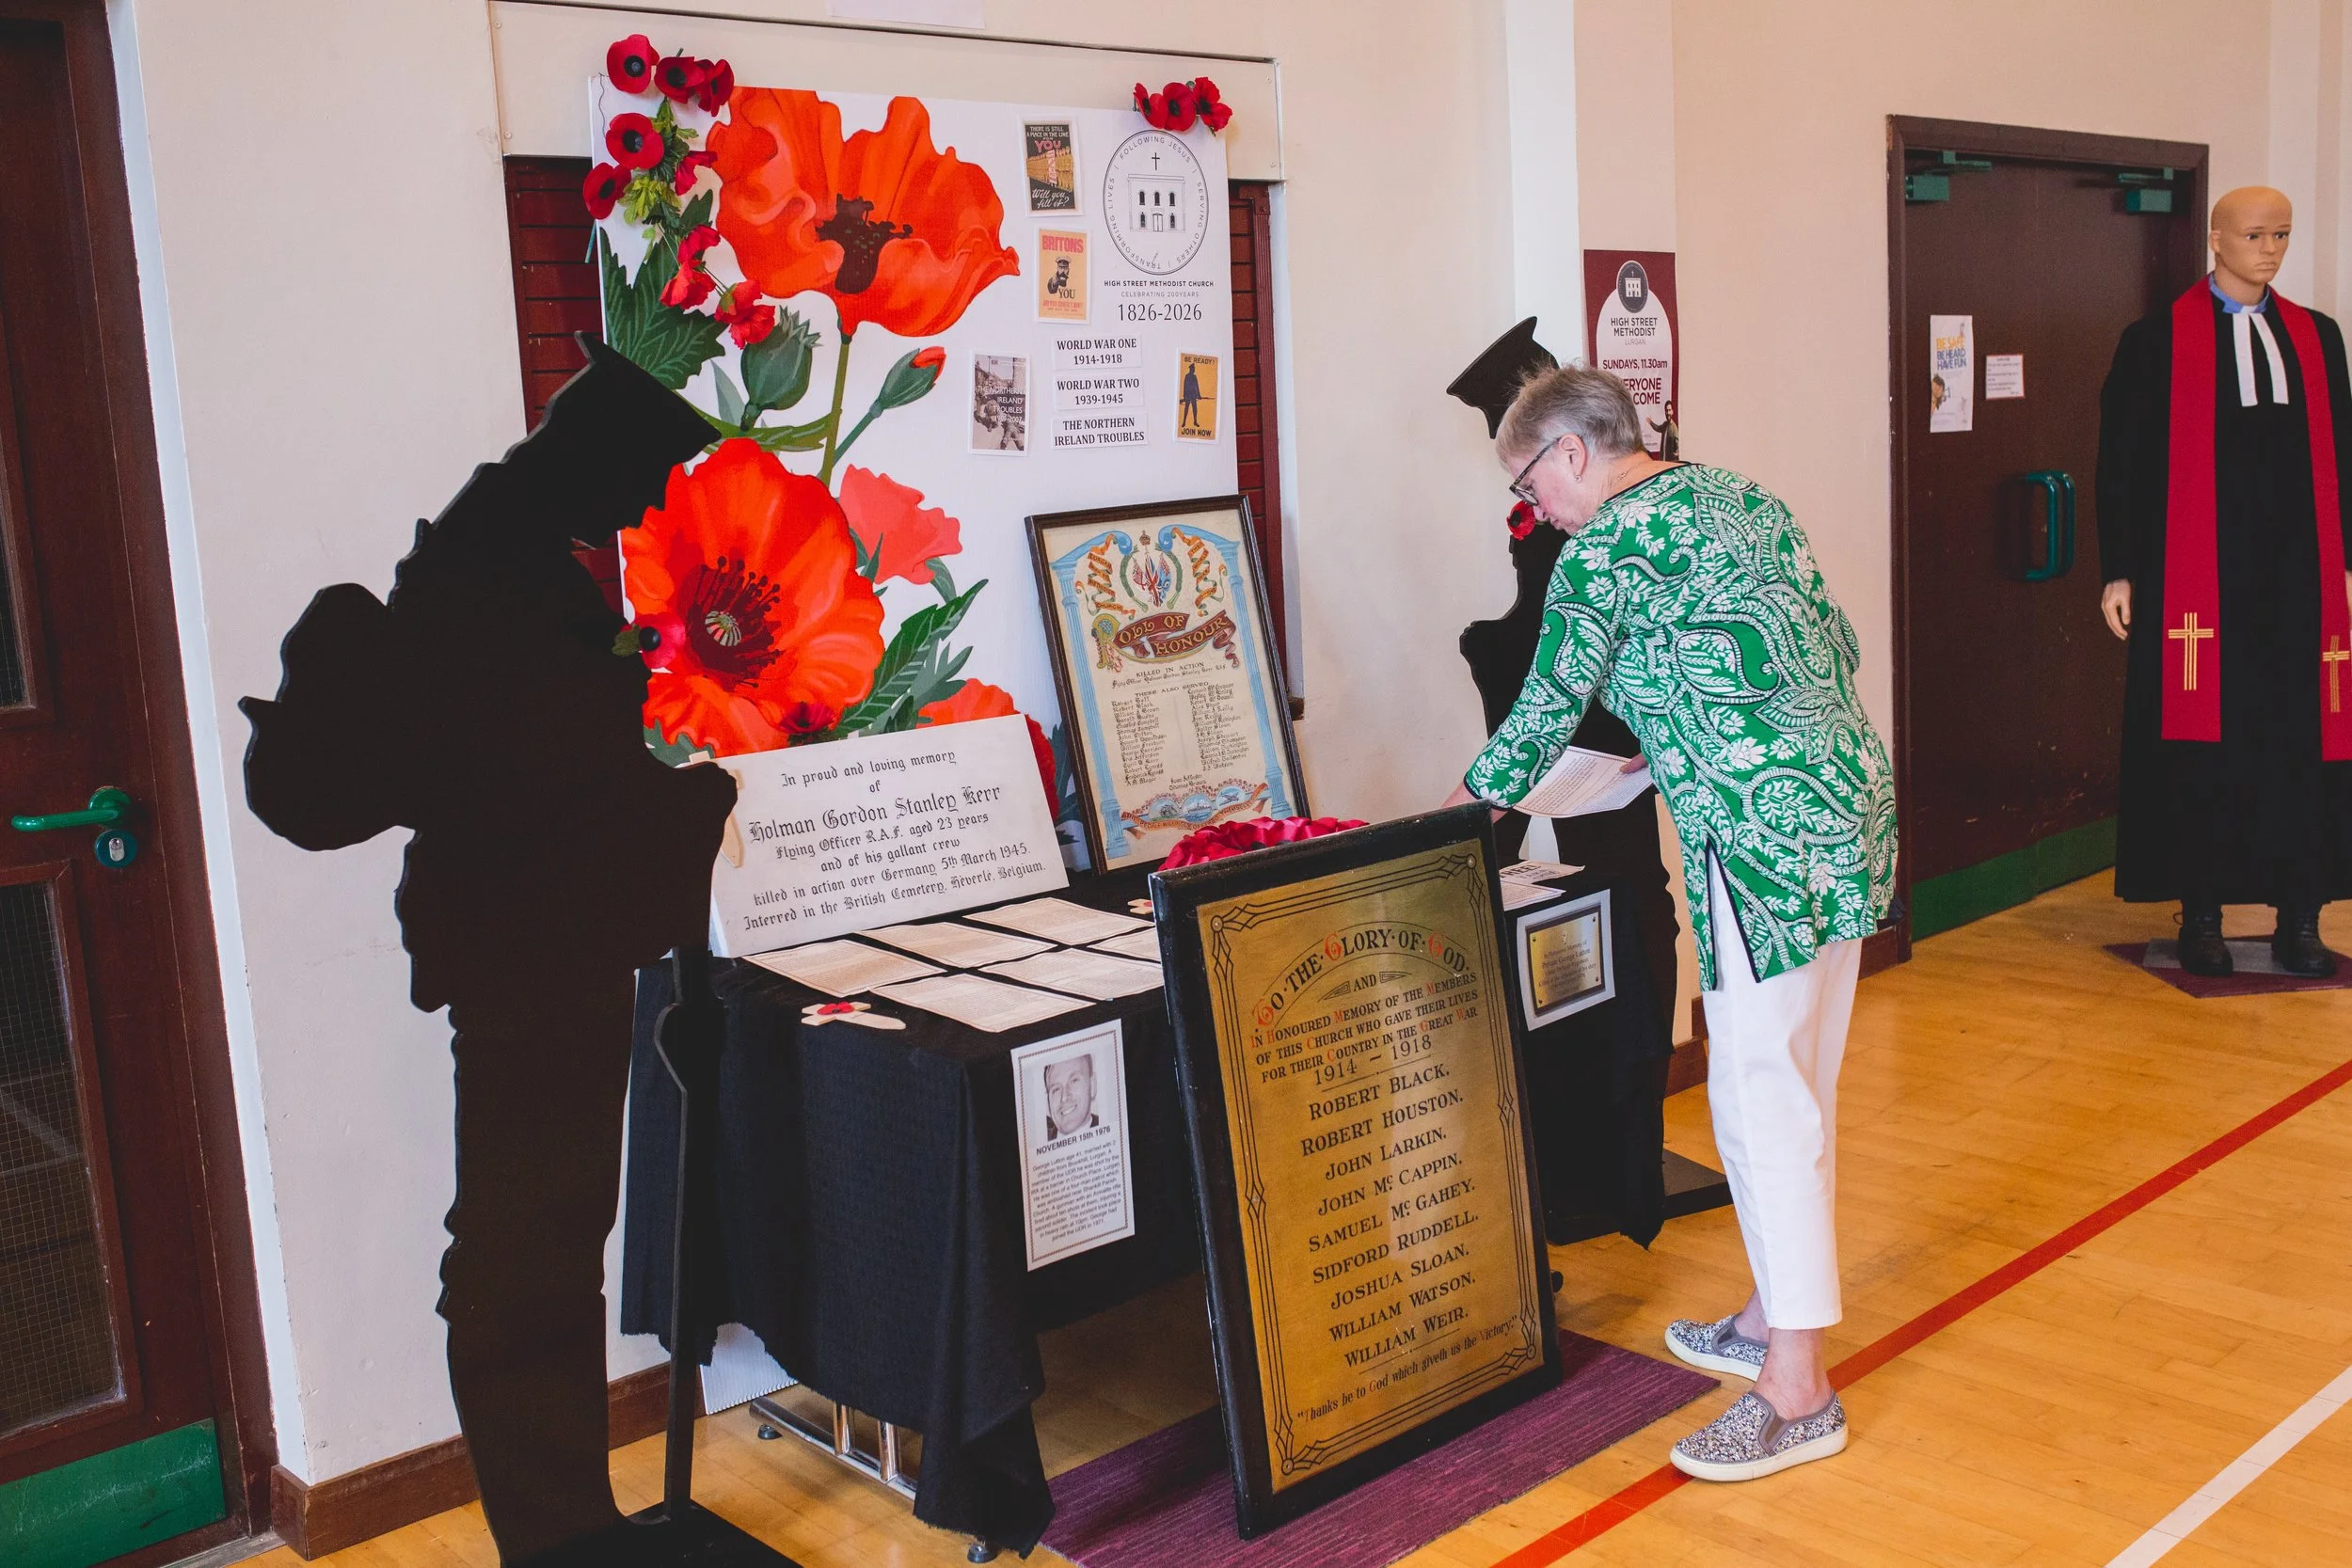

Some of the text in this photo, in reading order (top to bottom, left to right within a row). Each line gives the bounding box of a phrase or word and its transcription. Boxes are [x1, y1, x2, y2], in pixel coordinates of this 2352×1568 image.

[1035, 140, 1061, 153] YOU
[1120, 135, 1165, 160] FOLLOWING
[1168, 141, 1191, 164] JESUS
[1032, 188, 1066, 201] Will you
[1037, 198, 1053, 209] fill
[1042, 235, 1085, 254] BRITONS
[1109, 215, 1161, 270] TRANSFORMING
[1176, 232, 1200, 263] OTHERS
[1058, 288, 1076, 299] YOU
[1118, 303, 1202, 322] 1826-2026
[1611, 317, 1658, 326] HIGH STREET
[1613, 327, 1656, 337] METHODIST
[1057, 338, 1137, 351] WORLD WAR ONE
[1937, 348, 1966, 360] BE HEARD
[1073, 354, 1122, 366] 1914-1918
[1194, 356, 1217, 365] READY!
[1603, 358, 1668, 370] SUNDAYS, 11.30am
[1937, 358, 1967, 370] HAVE FUN
[1057, 377, 1140, 391] WORLD WAR TWO
[1624, 378, 1661, 390] ERYONE
[993, 405, 1023, 414] TROUBLES
[997, 396, 1023, 404] IRELAND
[1074, 393, 1124, 405] 1939-1945
[1063, 417, 1136, 431] THE NORTHERN
[1181, 427, 1212, 436] JOIN NOW
[1054, 431, 1145, 447] IRELAND TROUBLES
[1164, 615, 1185, 630] OF
[1155, 616, 1228, 656] HONOUR
[1136, 669, 1160, 677] KILLED
[1179, 662, 1204, 671] ACTION
[782, 752, 956, 788] In proud and loving memory
[869, 781, 881, 794] of
[749, 784, 1000, 845] Holman Gordon Stanley Kerr
[775, 813, 990, 862] Flying Officer R.A.F. aged 23 years
[820, 837, 961, 873] and of his gallant crew
[754, 843, 1031, 907] killed in action over Germany 5th March 1945.
[744, 909, 798, 931] Interred
[803, 905, 816, 919] in
[820, 901, 838, 917] the
[844, 892, 887, 911] British
[997, 861, 1046, 880] Belgium.
[1251, 992, 1285, 1027] TO
[1286, 954, 1323, 994] THE
[1324, 929, 1391, 961] GLORY
[1398, 931, 1422, 949] OF
[1353, 974, 1377, 991] AND
[1250, 972, 1477, 1049] IN HONOURED MEMORY OF THE MEMBERS
[1256, 990, 1478, 1067] OF THIS CHURCH WHO GAVE THEIR LIVES
[1262, 1007, 1476, 1083] FOR THEIR COUNTRY IN THE GREAT WAR
[1315, 1035, 1432, 1085] 1914 1918
[1309, 1063, 1451, 1121] ROBERT BLACK.
[1300, 1089, 1464, 1157] ROBERT HOUSTON.
[1036, 1136, 1077, 1156] NOVEMBER
[1079, 1132, 1093, 1142] 15th
[1326, 1127, 1447, 1180] JOHN LARKIN.
[1318, 1187, 1365, 1216] JOHN
[1399, 1152, 1463, 1185] CAPPIN.
[1309, 1215, 1383, 1253] SAMUEL
[1416, 1178, 1475, 1211] GAHEY.
[1313, 1211, 1479, 1285] SIDFORD RUDDELL.
[1330, 1243, 1470, 1309] JOSHUA SLOAN.
[1328, 1272, 1476, 1342] WILLIAM WATSON.
[1344, 1306, 1469, 1369] WILLIAM WEIR.
[1342, 1392, 1354, 1404] be
[1357, 1386, 1367, 1398] to
[1369, 1377, 1389, 1393] God
[1391, 1363, 1419, 1383] which
[1422, 1349, 1448, 1371] giveth
[1450, 1344, 1461, 1356] us
[1463, 1337, 1477, 1352] the
